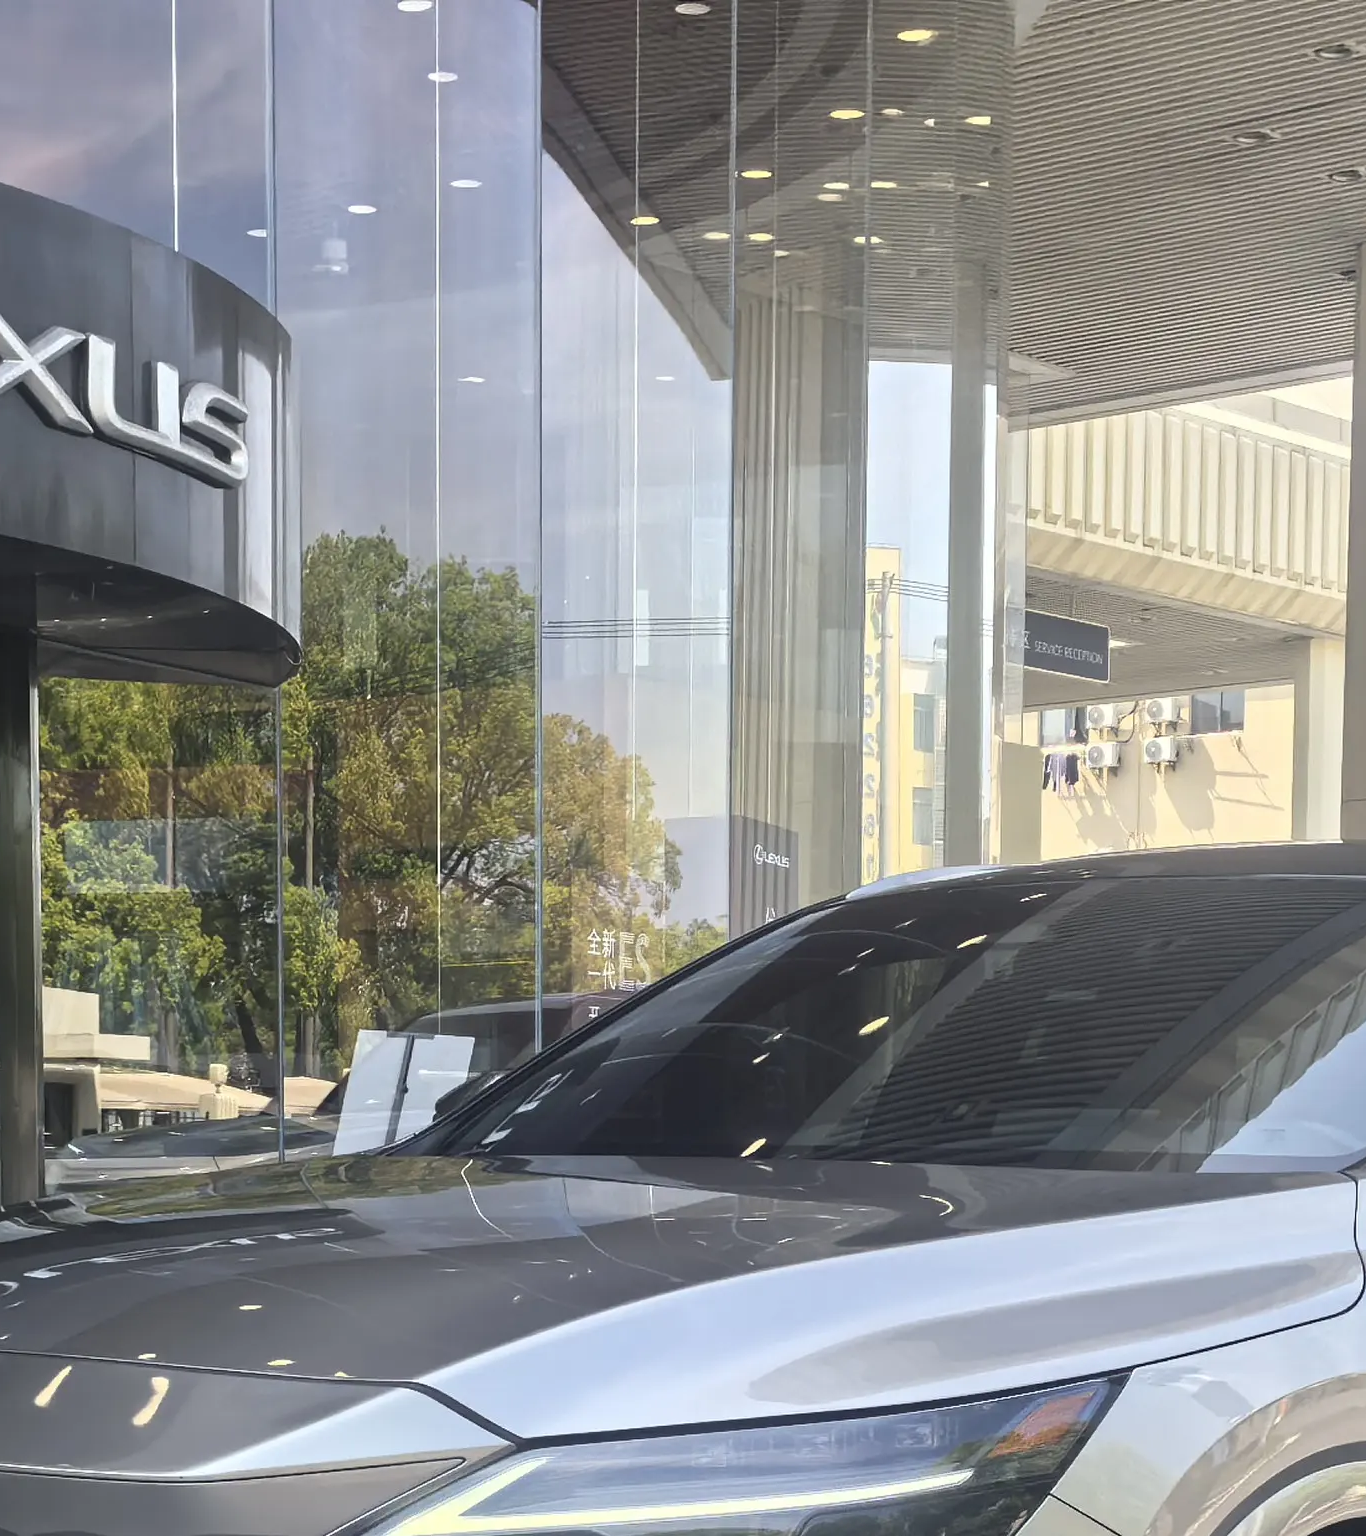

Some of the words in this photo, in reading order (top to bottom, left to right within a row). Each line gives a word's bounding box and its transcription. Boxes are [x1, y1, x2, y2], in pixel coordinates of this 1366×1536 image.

[1034, 640, 1063, 657] SERVICE
[764, 851, 790, 868] LEXUS
[586, 928, 616, 959] 全新
[586, 960, 617, 991] 一代
